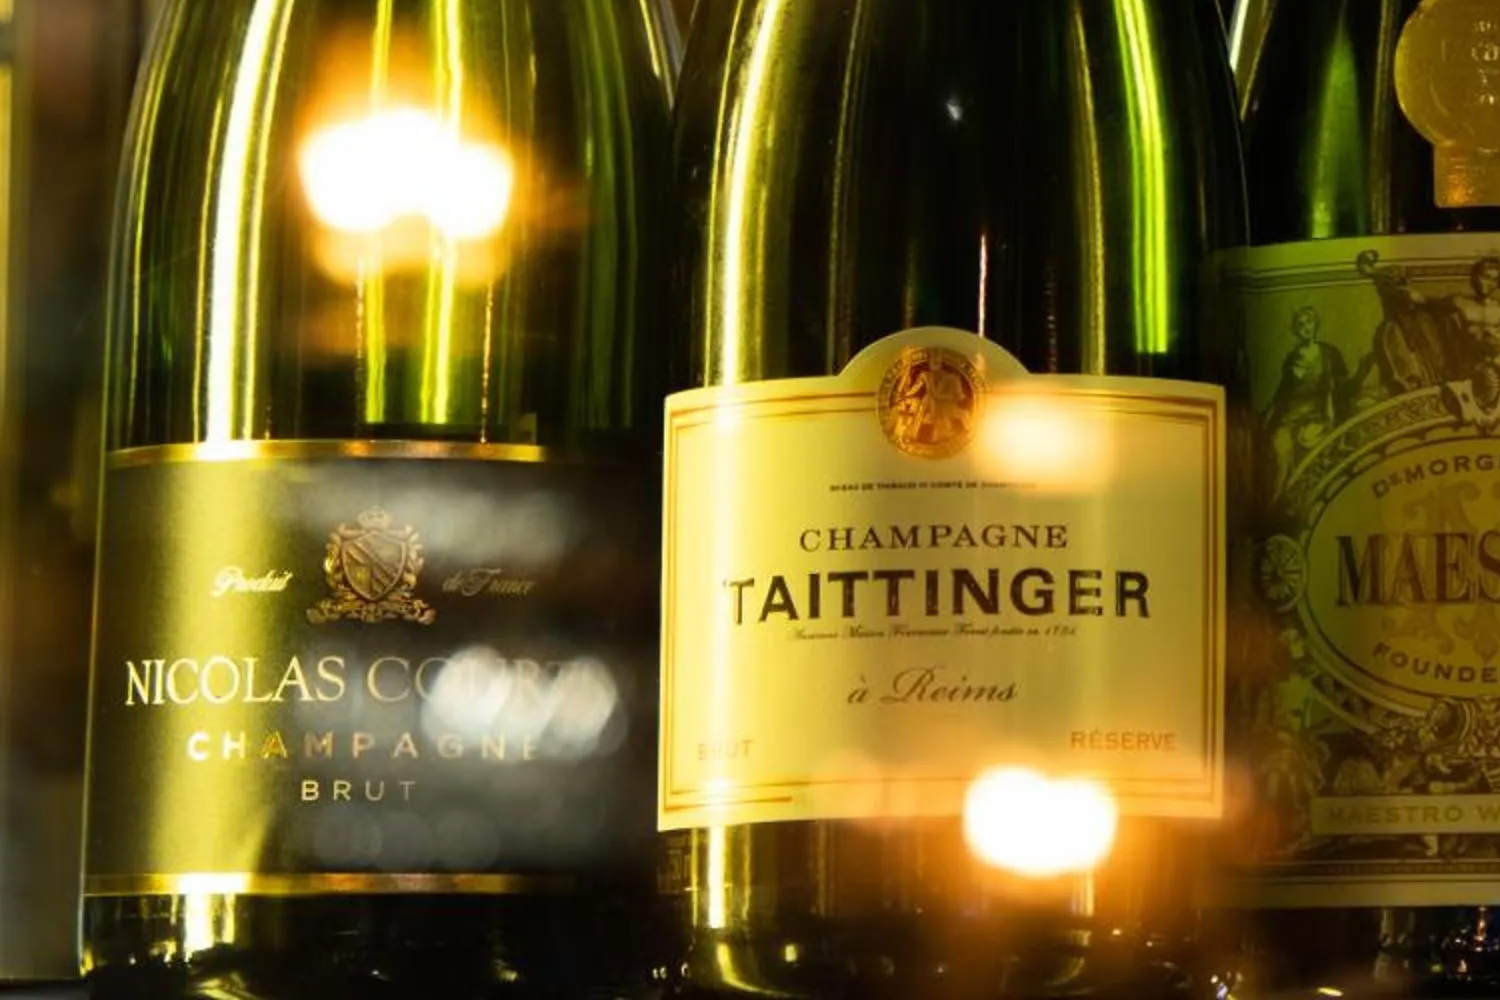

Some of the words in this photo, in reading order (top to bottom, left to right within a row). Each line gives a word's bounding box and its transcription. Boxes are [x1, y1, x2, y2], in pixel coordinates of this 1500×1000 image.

[799, 524, 1069, 553] CHAMPAGNE
[727, 567, 1151, 626] TAITTINGER
[125, 655, 346, 706] NICOLAS
[847, 676, 871, 706] à
[880, 665, 1019, 705] Reims
[187, 730, 540, 762] CHAMPAGNE
[1070, 726, 1178, 753] RÉSERVE
[301, 779, 417, 802] BRUT
[1329, 804, 1464, 823] MAESTRO
